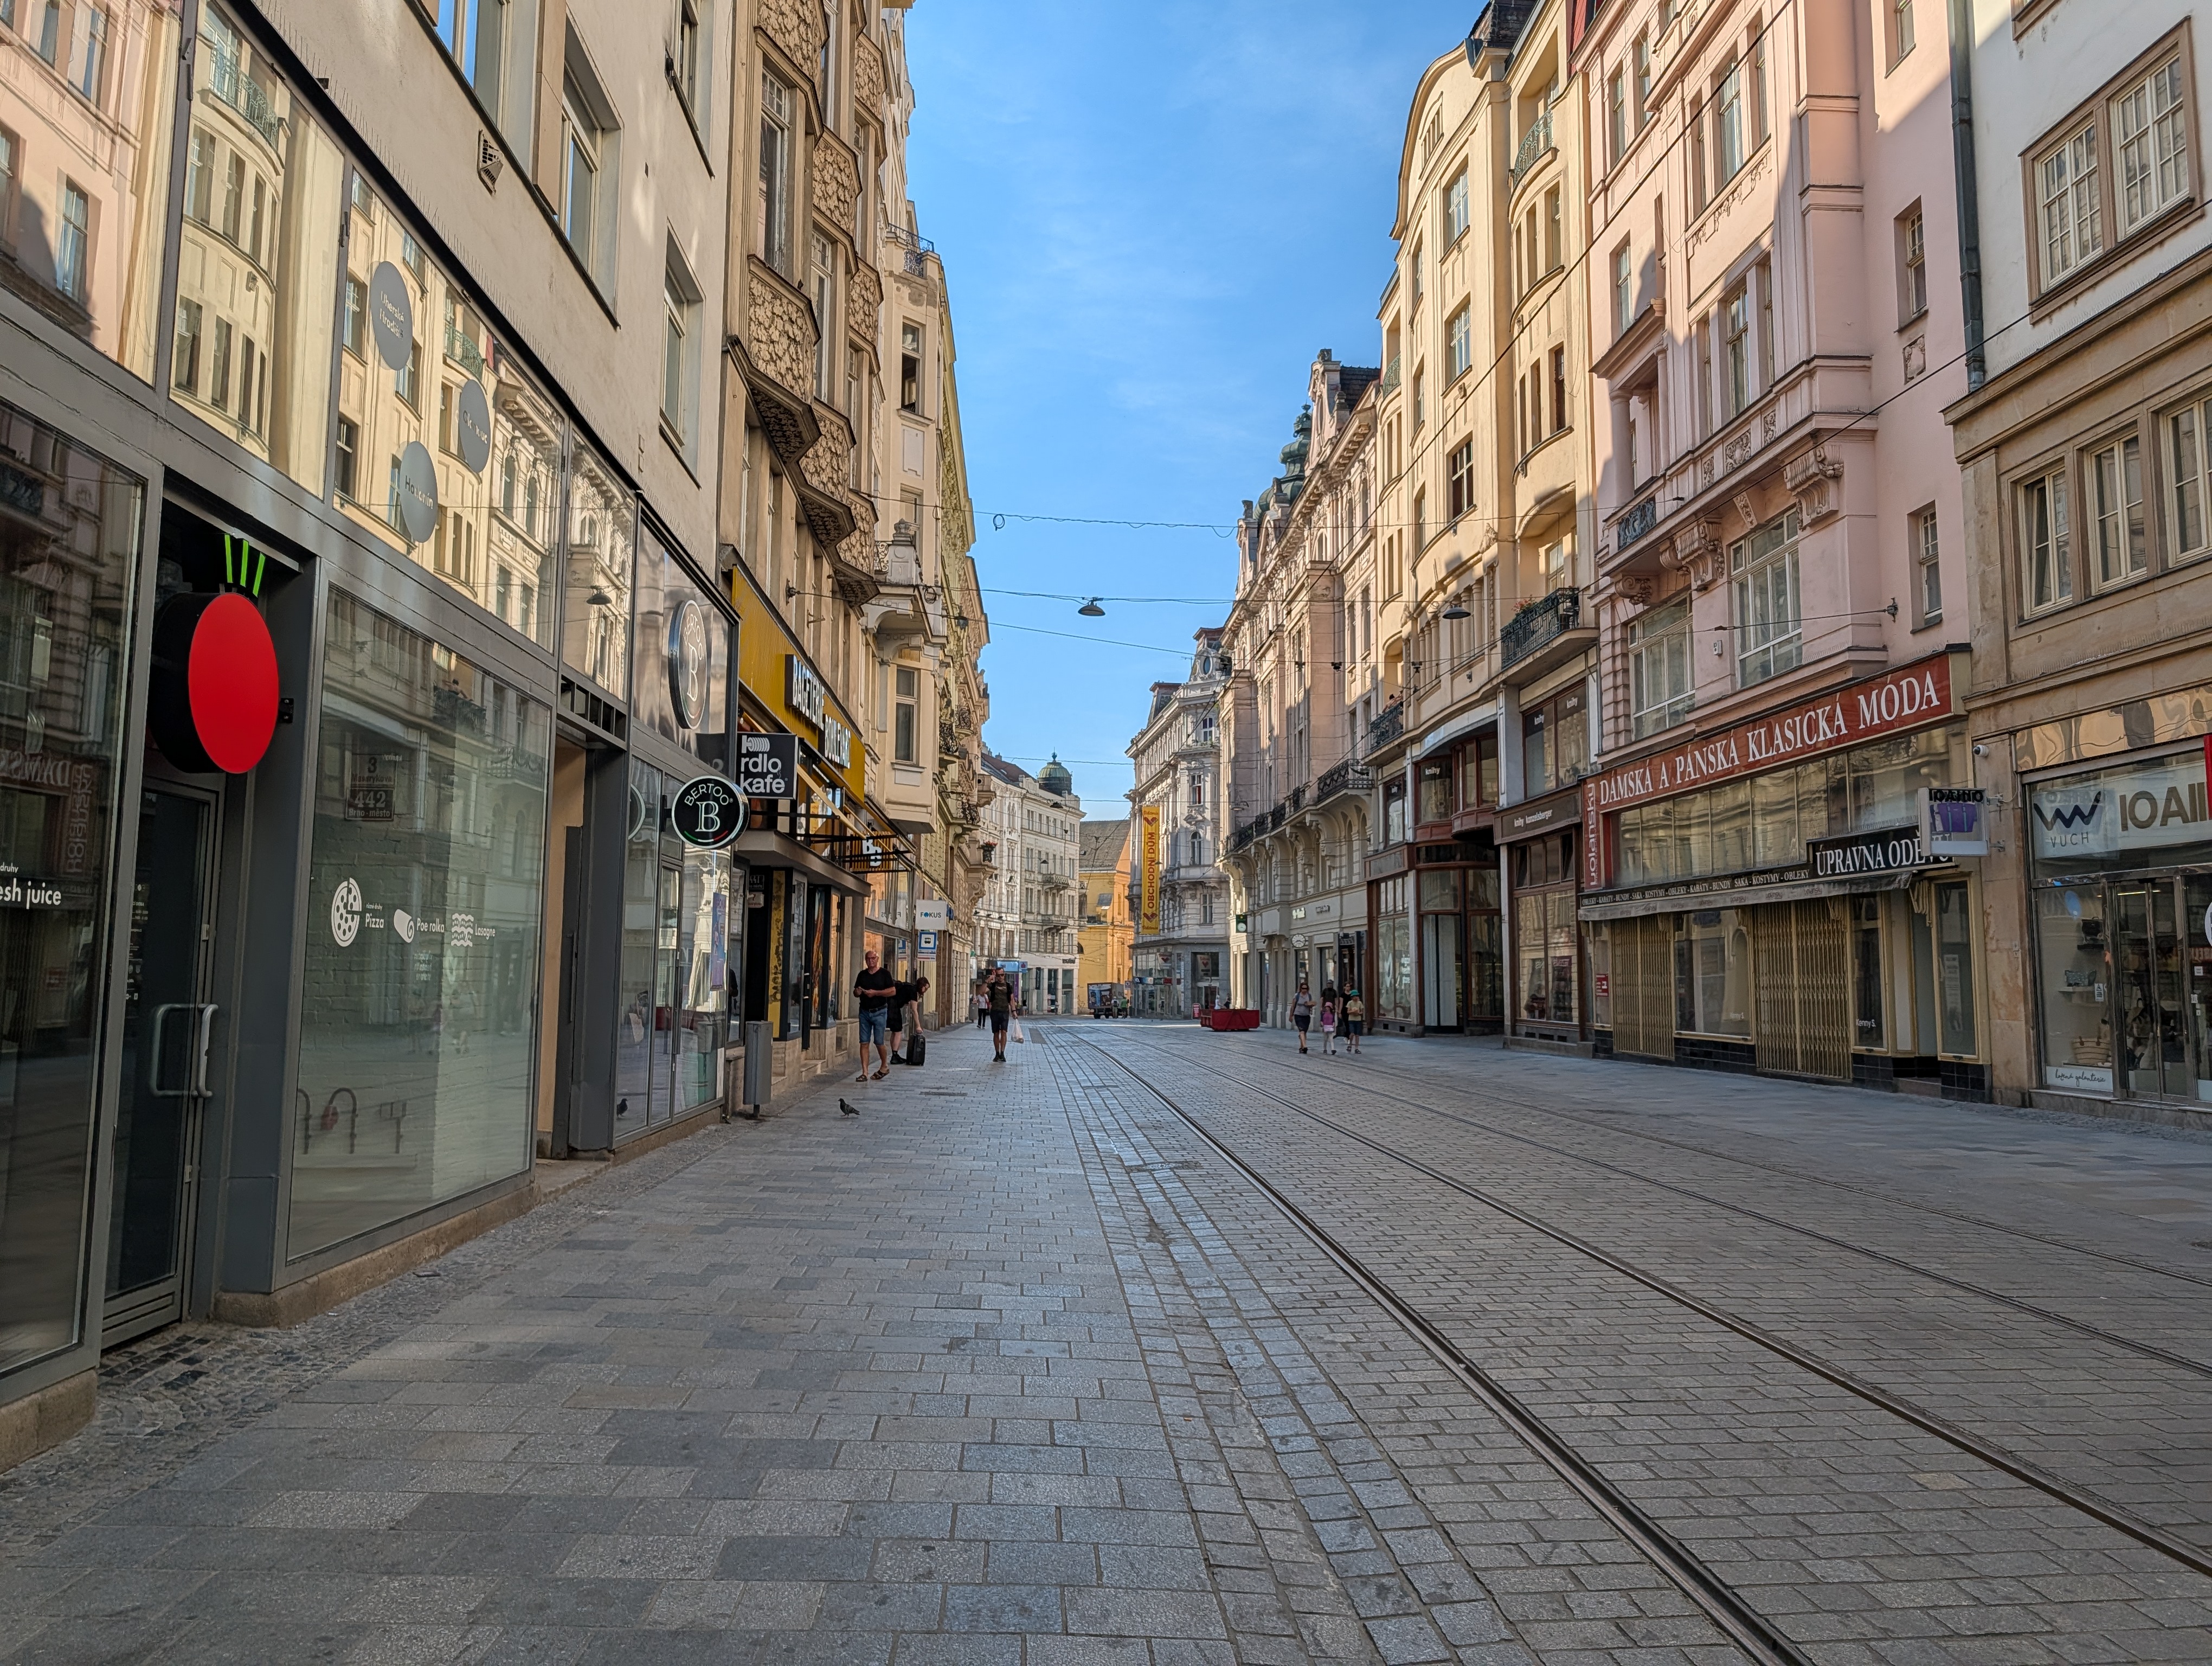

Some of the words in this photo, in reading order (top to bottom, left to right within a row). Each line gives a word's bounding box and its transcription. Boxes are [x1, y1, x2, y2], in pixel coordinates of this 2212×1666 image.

[683, 614, 703, 661] BERTOO
[793, 654, 826, 732] BAGETERIE
[1600, 761, 1654, 804] DÁMSKÁ
[1659, 770, 1670, 789] A
[1675, 729, 1739, 784] PÁNSKÁ
[1747, 693, 1848, 762] KLASICKÁ
[1857, 671, 1940, 729] MÓDA
[368, 757, 377, 773] 3
[741, 753, 782, 773] rdlo
[740, 773, 785, 793] kafe
[355, 792, 386, 808] 442
[684, 783, 729, 806] BERTOO
[349, 808, 365, 817] Brno
[369, 808, 390, 817] město
[695, 801, 721, 832] B
[1146, 832, 1155, 855] DŮM
[2050, 831, 2090, 848] VUCH
[0, 862, 18, 873] druhy
[1816, 843, 1886, 876] ÚPRAVNA
[1147, 857, 1155, 909] OBCHODNÍ
[1632, 892, 1643, 900] SAKA
[1668, 886, 1687, 895] OBLEKY
[1690, 881, 1709, 893] KABÁTY
[1713, 880, 1731, 890] BUNDY
[1735, 876, 1749, 887] SAKA
[1752, 872, 1780, 885] KOSTÝMY
[1784, 869, 1810, 881] OBLEKY
[26, 880, 61, 909] juice
[365, 913, 384, 928] Pizza
[417, 918, 428, 932] Poe
[429, 918, 445, 933] rolka
[475, 923, 496, 940] Lasagne
[1856, 1018, 1871, 1028] Kenny
[2075, 1071, 2106, 1087] galanterie
